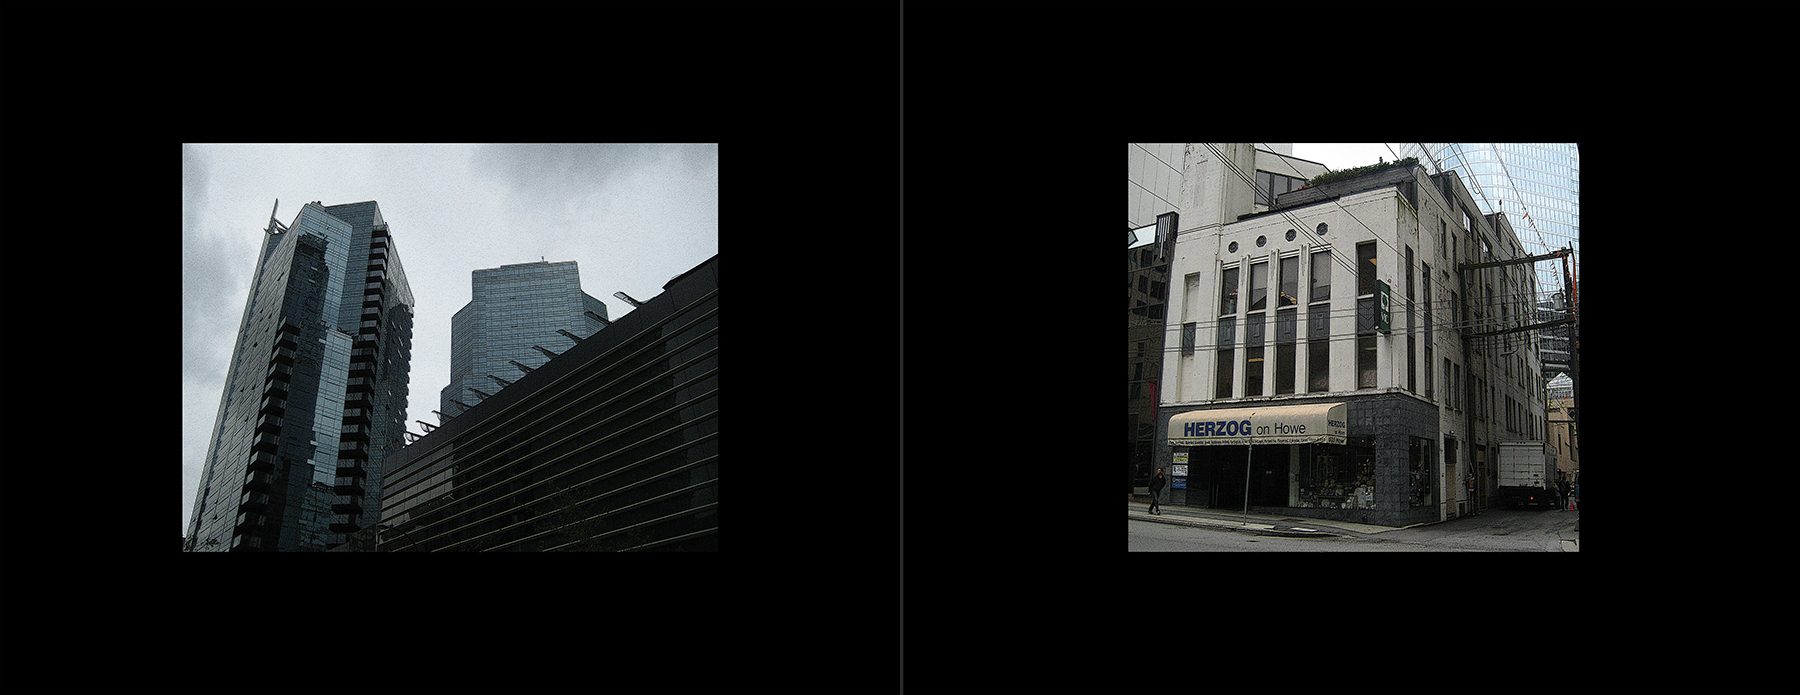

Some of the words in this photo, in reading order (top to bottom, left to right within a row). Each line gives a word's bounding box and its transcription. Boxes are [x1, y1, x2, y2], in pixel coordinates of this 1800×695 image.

[1184, 420, 1252, 437] HERZOG
[1256, 425, 1270, 435] on
[1274, 422, 1306, 434] Howe
